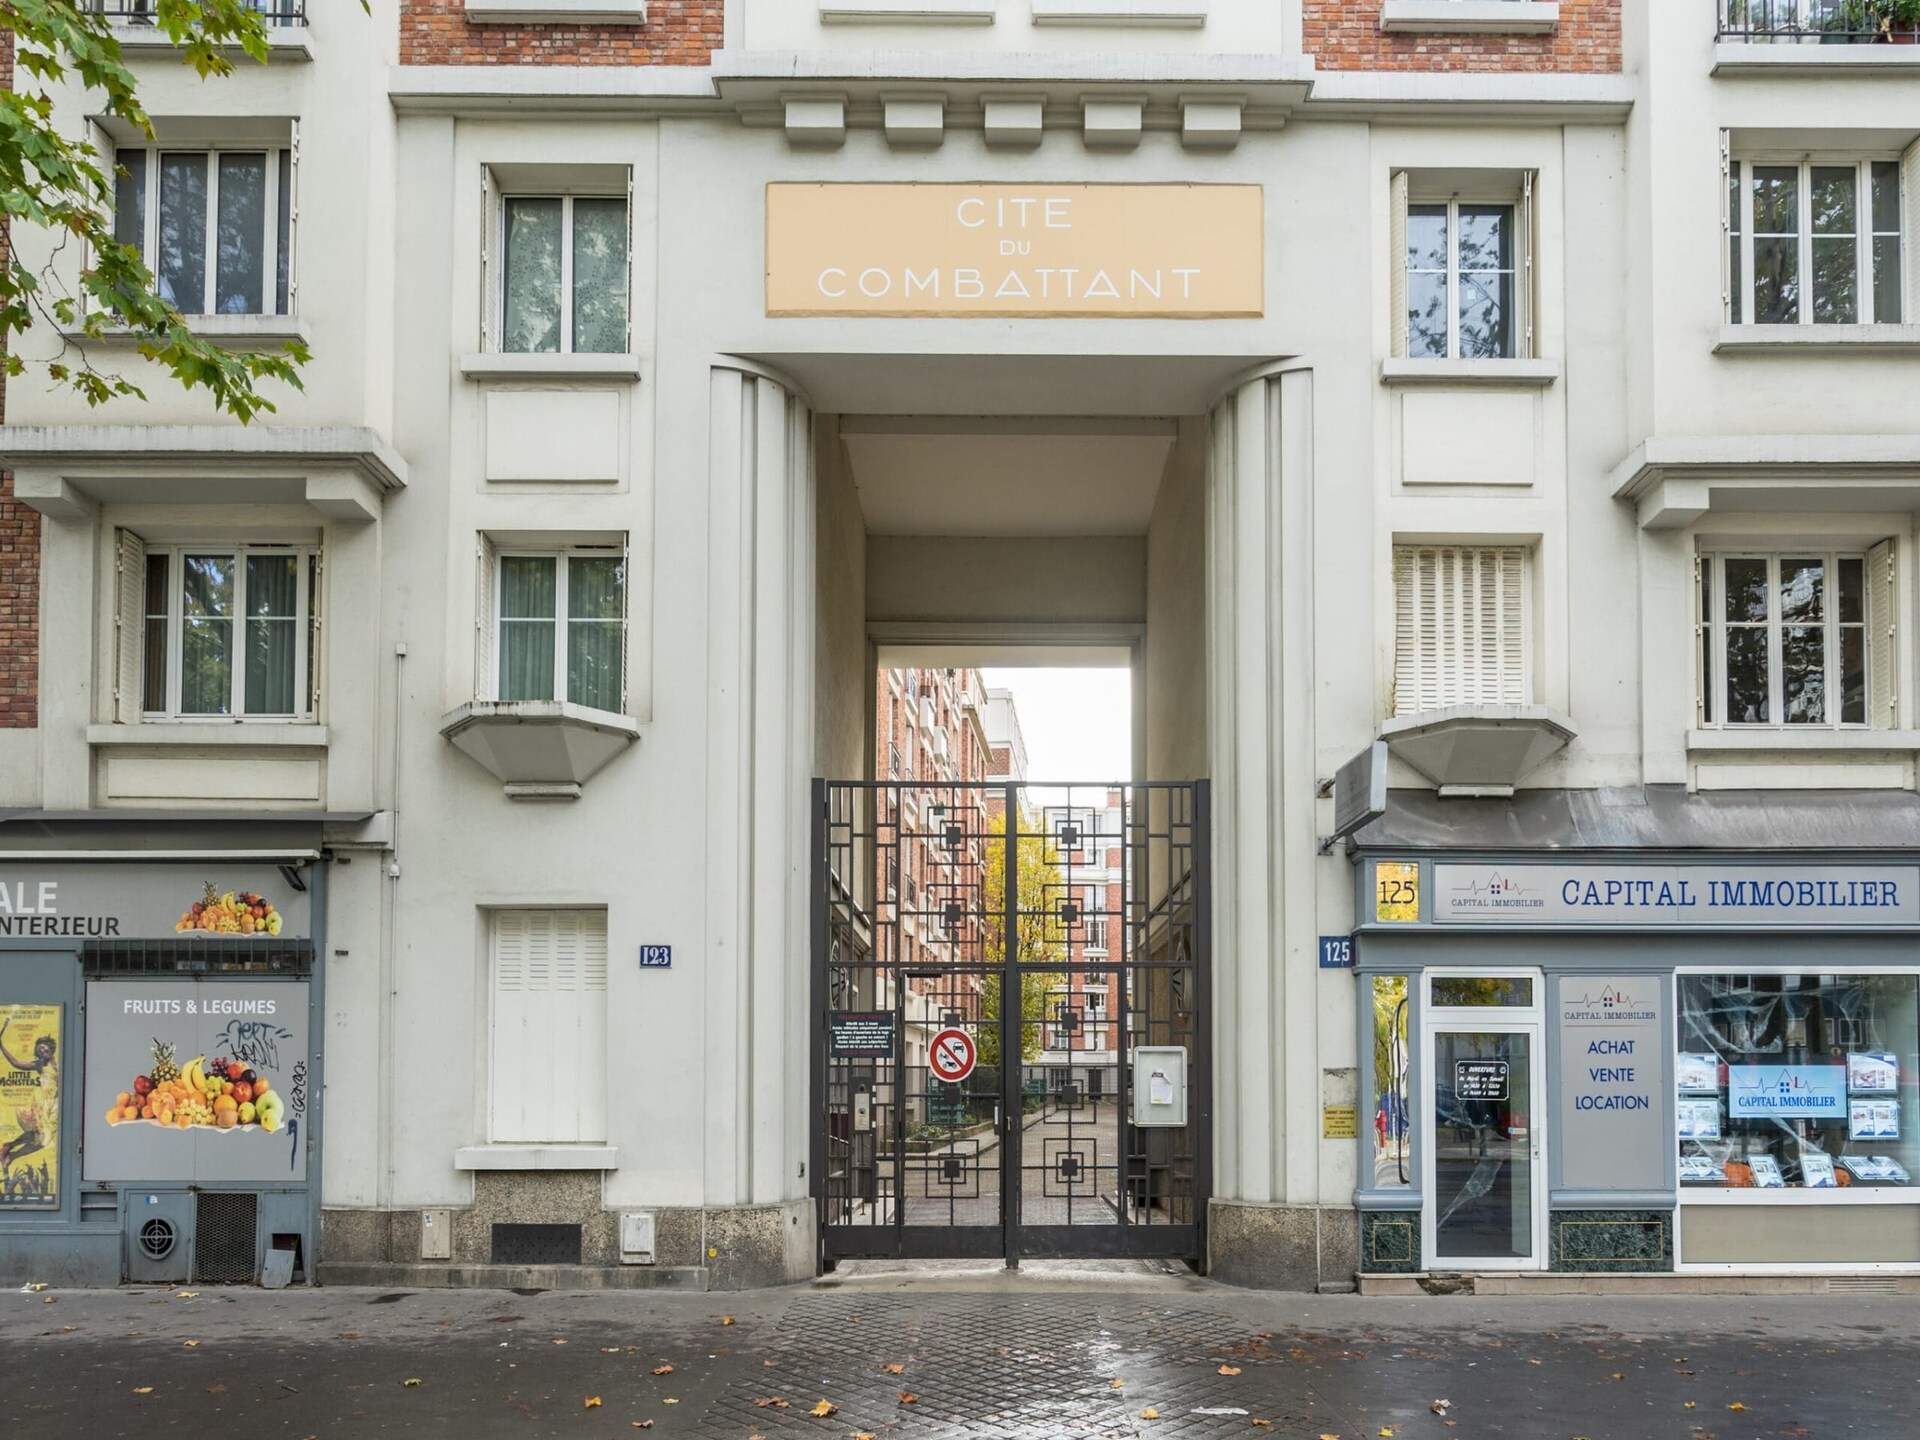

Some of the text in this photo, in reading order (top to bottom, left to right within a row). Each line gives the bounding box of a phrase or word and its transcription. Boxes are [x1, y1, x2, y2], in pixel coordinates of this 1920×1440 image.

[957, 198, 1072, 228] CITE
[1000, 240, 1031, 256] DU
[818, 268, 1201, 299] COMBATTANT
[1380, 880, 1415, 905] 125
[1563, 879, 1900, 907] CAPITAL IMMOBILIER
[1451, 899, 1544, 907] CAPITAL IMMOBILIER
[642, 946, 669, 965] 123
[1325, 941, 1350, 962] 125
[123, 1000, 276, 1014] FRUITS & LEGUMES
[1564, 1011, 1657, 1020] CAPITAL IMMOBILIER
[1587, 1040, 1635, 1055] ACHAT
[8, 1071, 32, 1079] LITTLE
[1589, 1067, 1635, 1082] VENTE
[1575, 1095, 1649, 1111] LOCATION
[1738, 1096, 1836, 1107] CAPITAL IMMOBILIER
